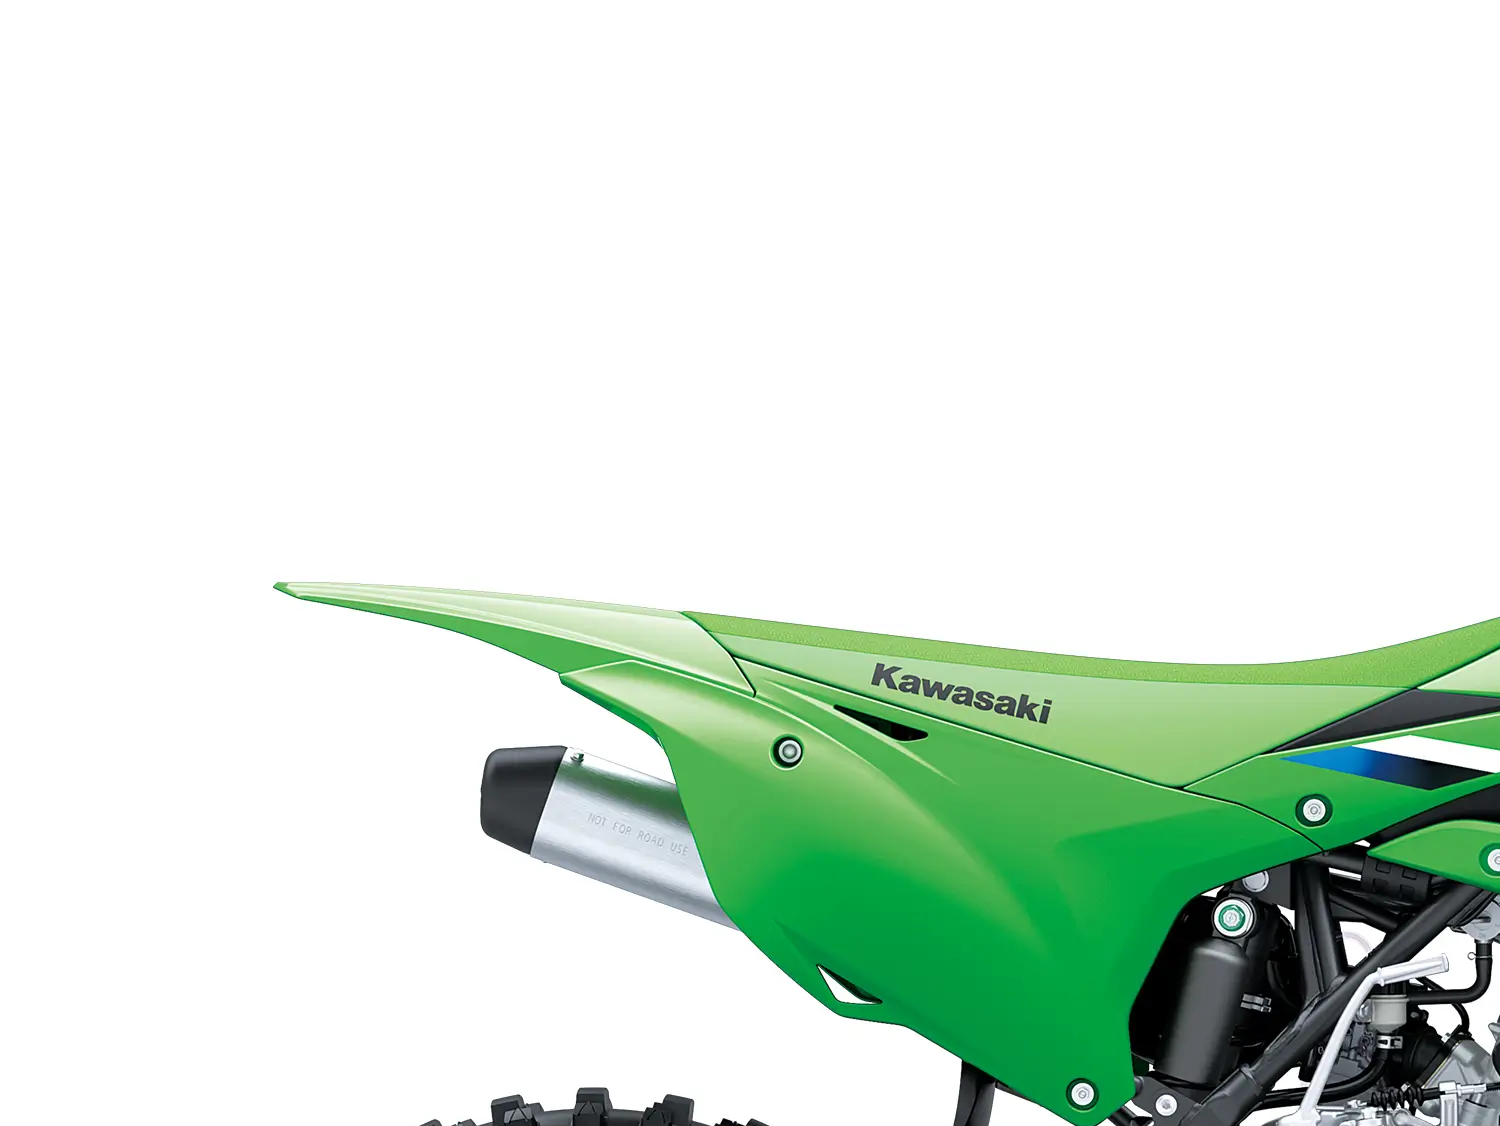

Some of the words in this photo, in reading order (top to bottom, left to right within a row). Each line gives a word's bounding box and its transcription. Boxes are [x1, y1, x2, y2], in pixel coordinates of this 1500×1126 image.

[871, 662, 1052, 724] Kawasaki
[587, 812, 608, 827] NOT
[612, 821, 632, 836] FOR
[637, 829, 665, 848] ROAD
[669, 841, 689, 857] USE
